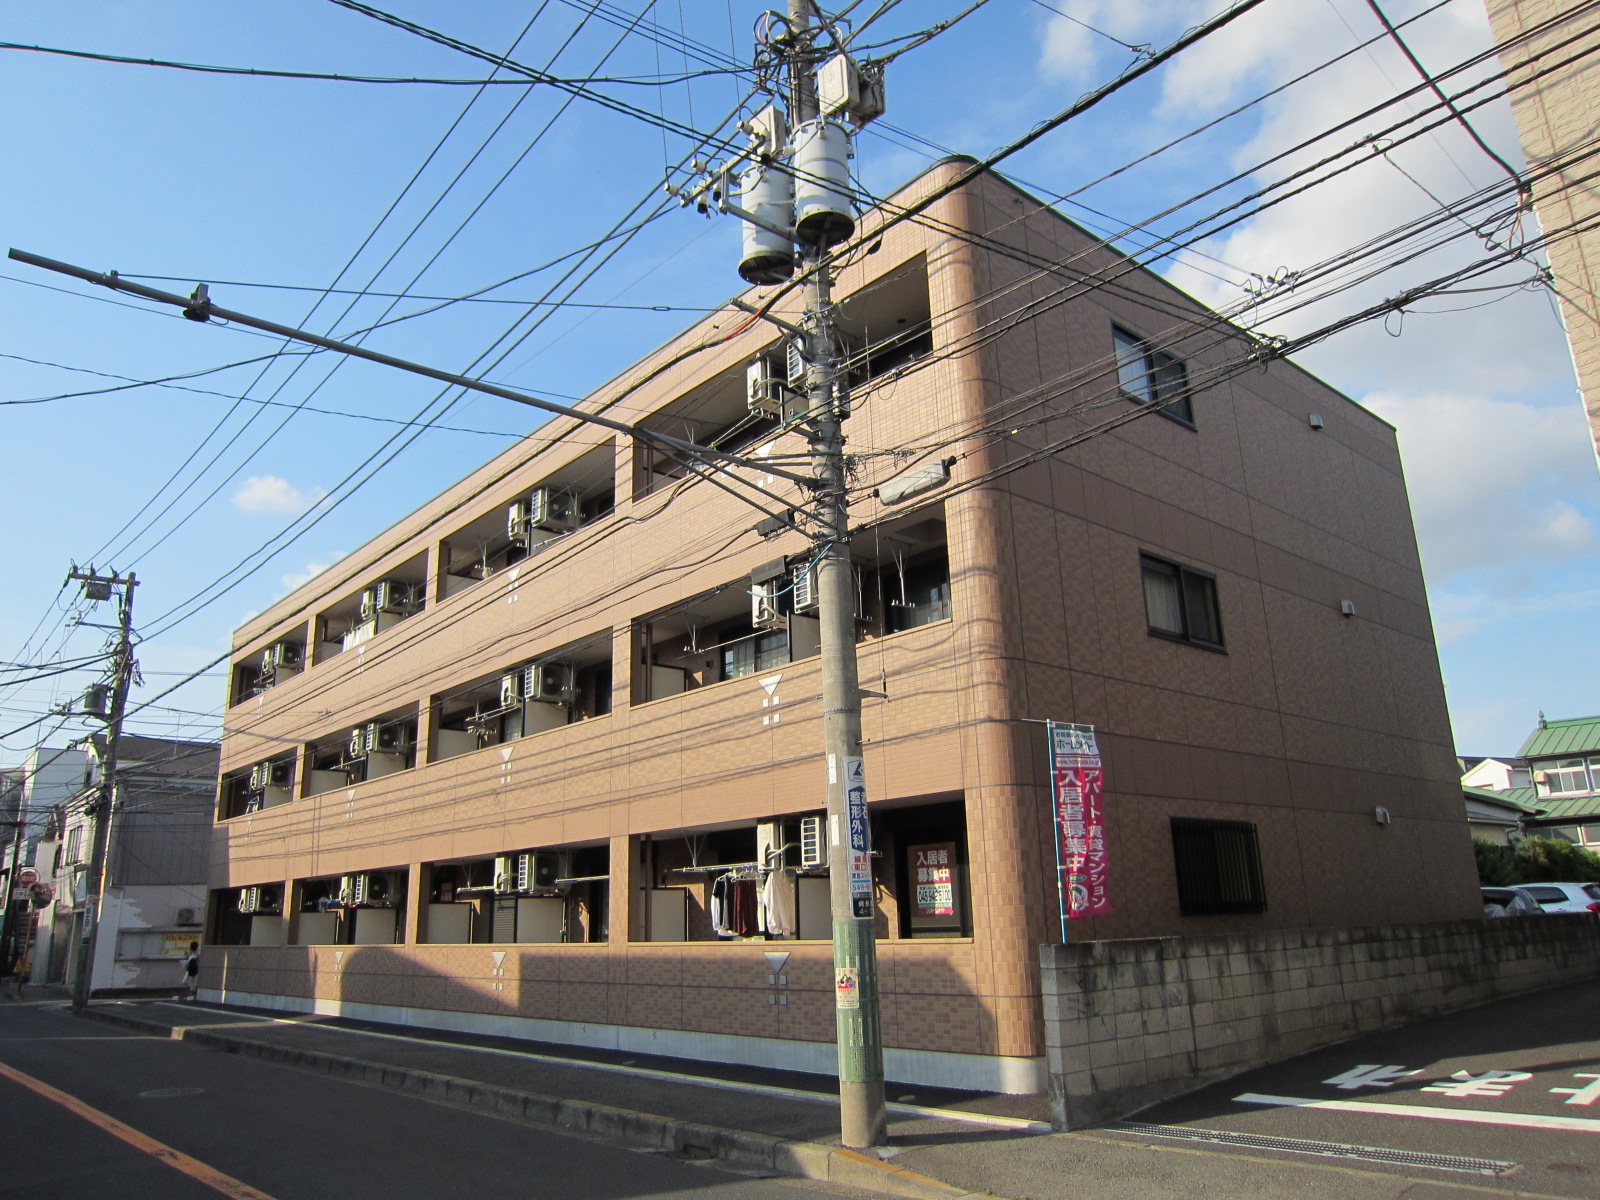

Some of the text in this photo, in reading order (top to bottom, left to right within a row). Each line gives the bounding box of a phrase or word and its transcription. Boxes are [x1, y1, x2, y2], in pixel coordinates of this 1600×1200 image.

[849, 790, 865, 848] 整形外科
[1058, 769, 1087, 872] 入居者募集中
[1083, 769, 1106, 909] アパート・賃貸マンション
[916, 849, 948, 866] 入居者
[917, 867, 950, 883] 募集中
